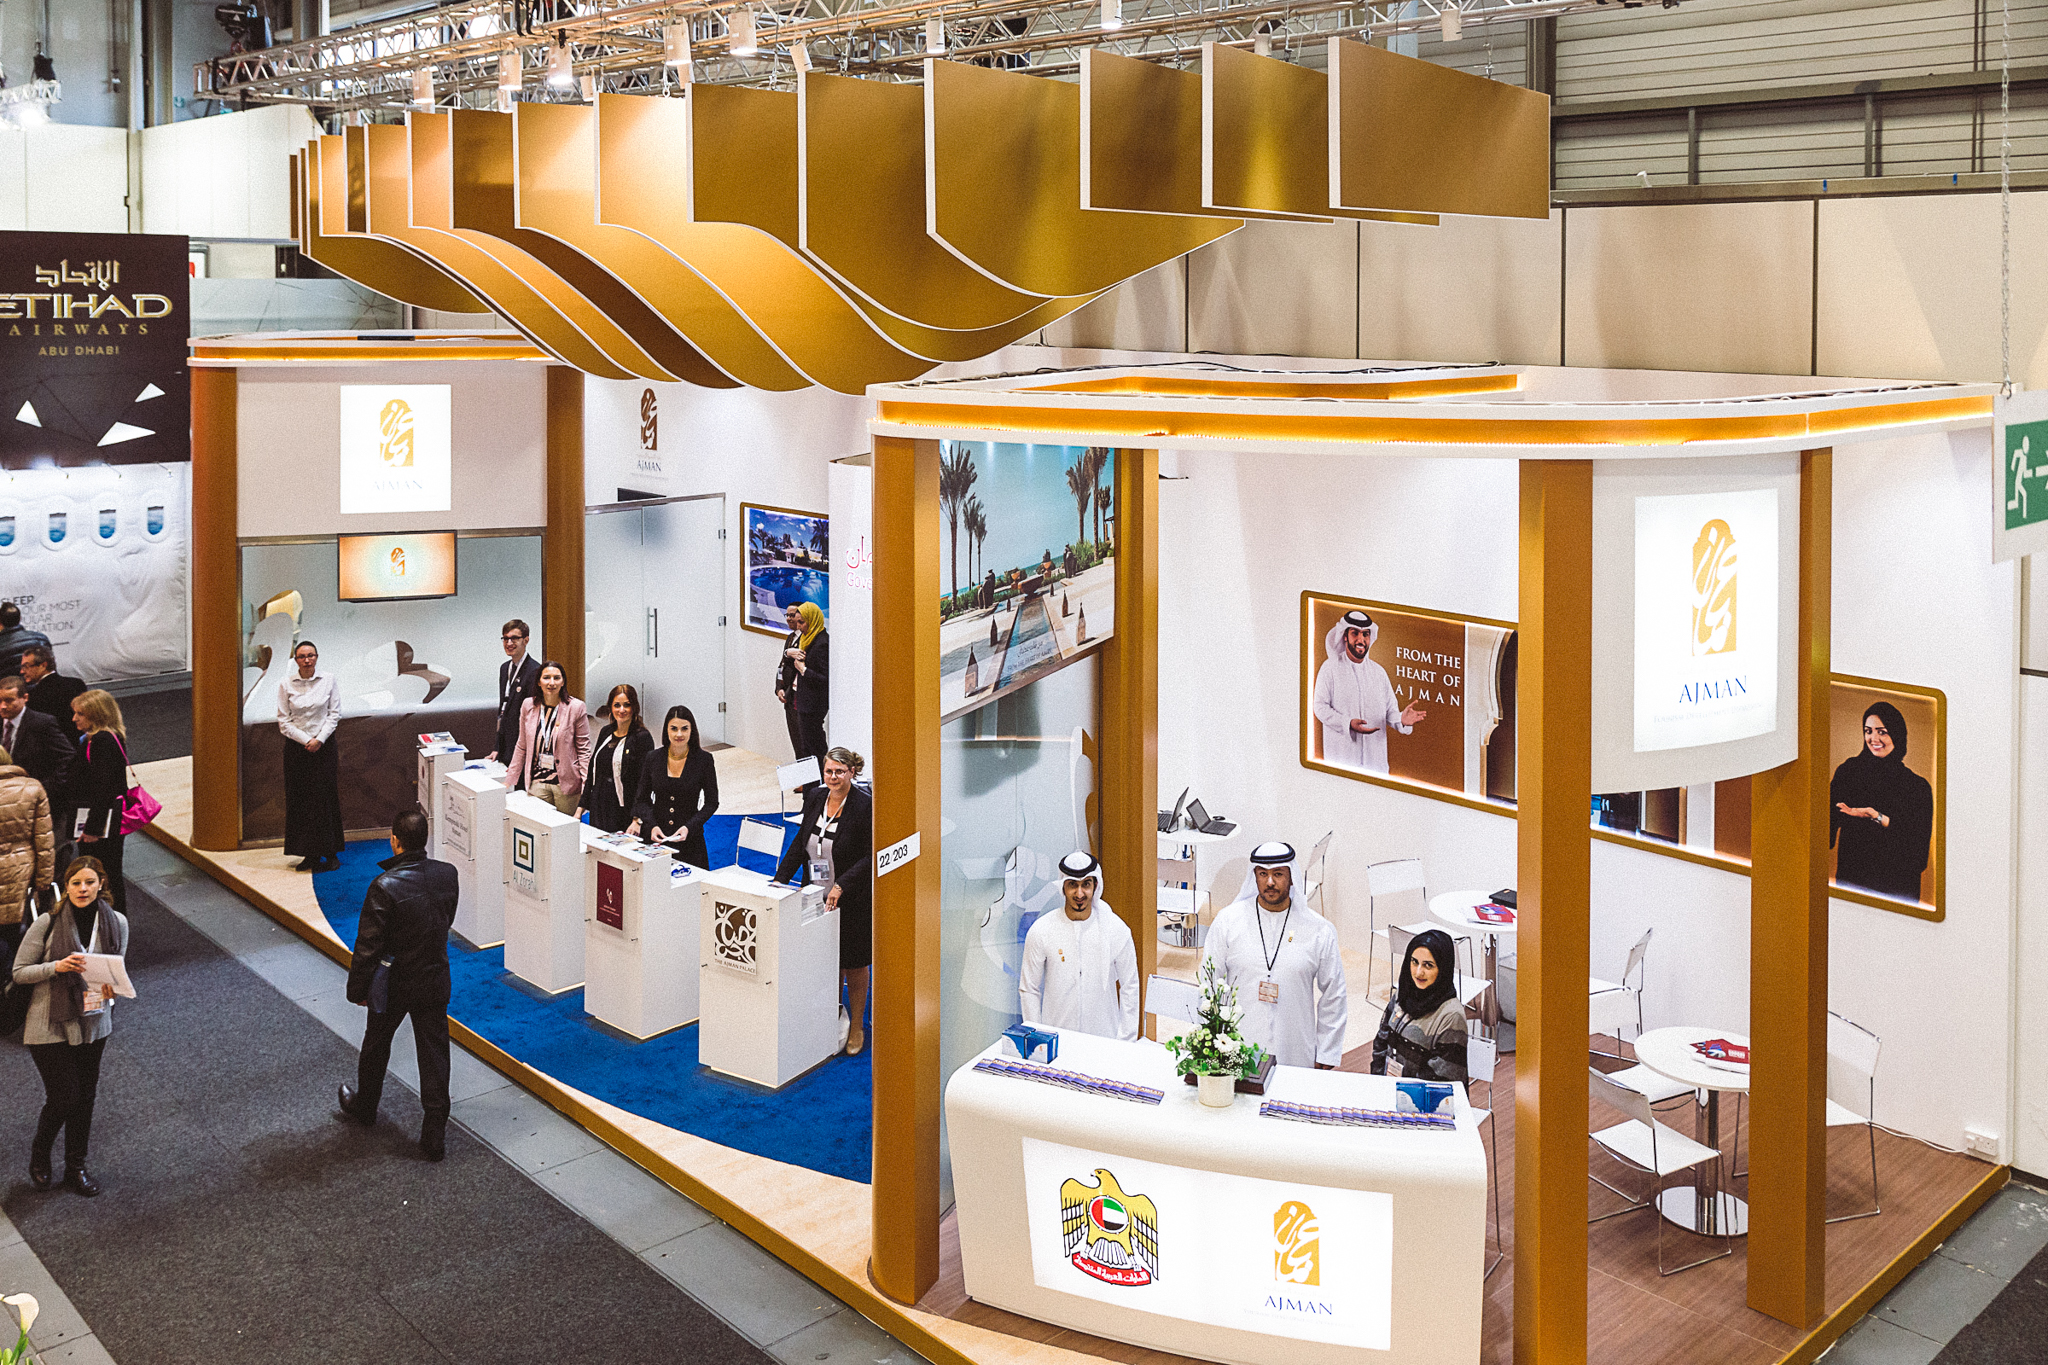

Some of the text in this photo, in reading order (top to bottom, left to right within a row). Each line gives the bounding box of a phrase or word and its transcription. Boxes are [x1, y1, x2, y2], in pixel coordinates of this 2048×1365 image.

[8, 323, 149, 336] AIRWAYS
[38, 345, 120, 356] ABU DHABI
[1395, 646, 1461, 669] FROM THE
[1395, 665, 1461, 688] HEART OF
[1395, 683, 1460, 707] AJMAN
[1678, 674, 1748, 706] AJMAN
[880, 844, 908, 868] 22 203
[739, 965, 755, 973] PALACE
[1264, 1295, 1333, 1315] AJMAN
